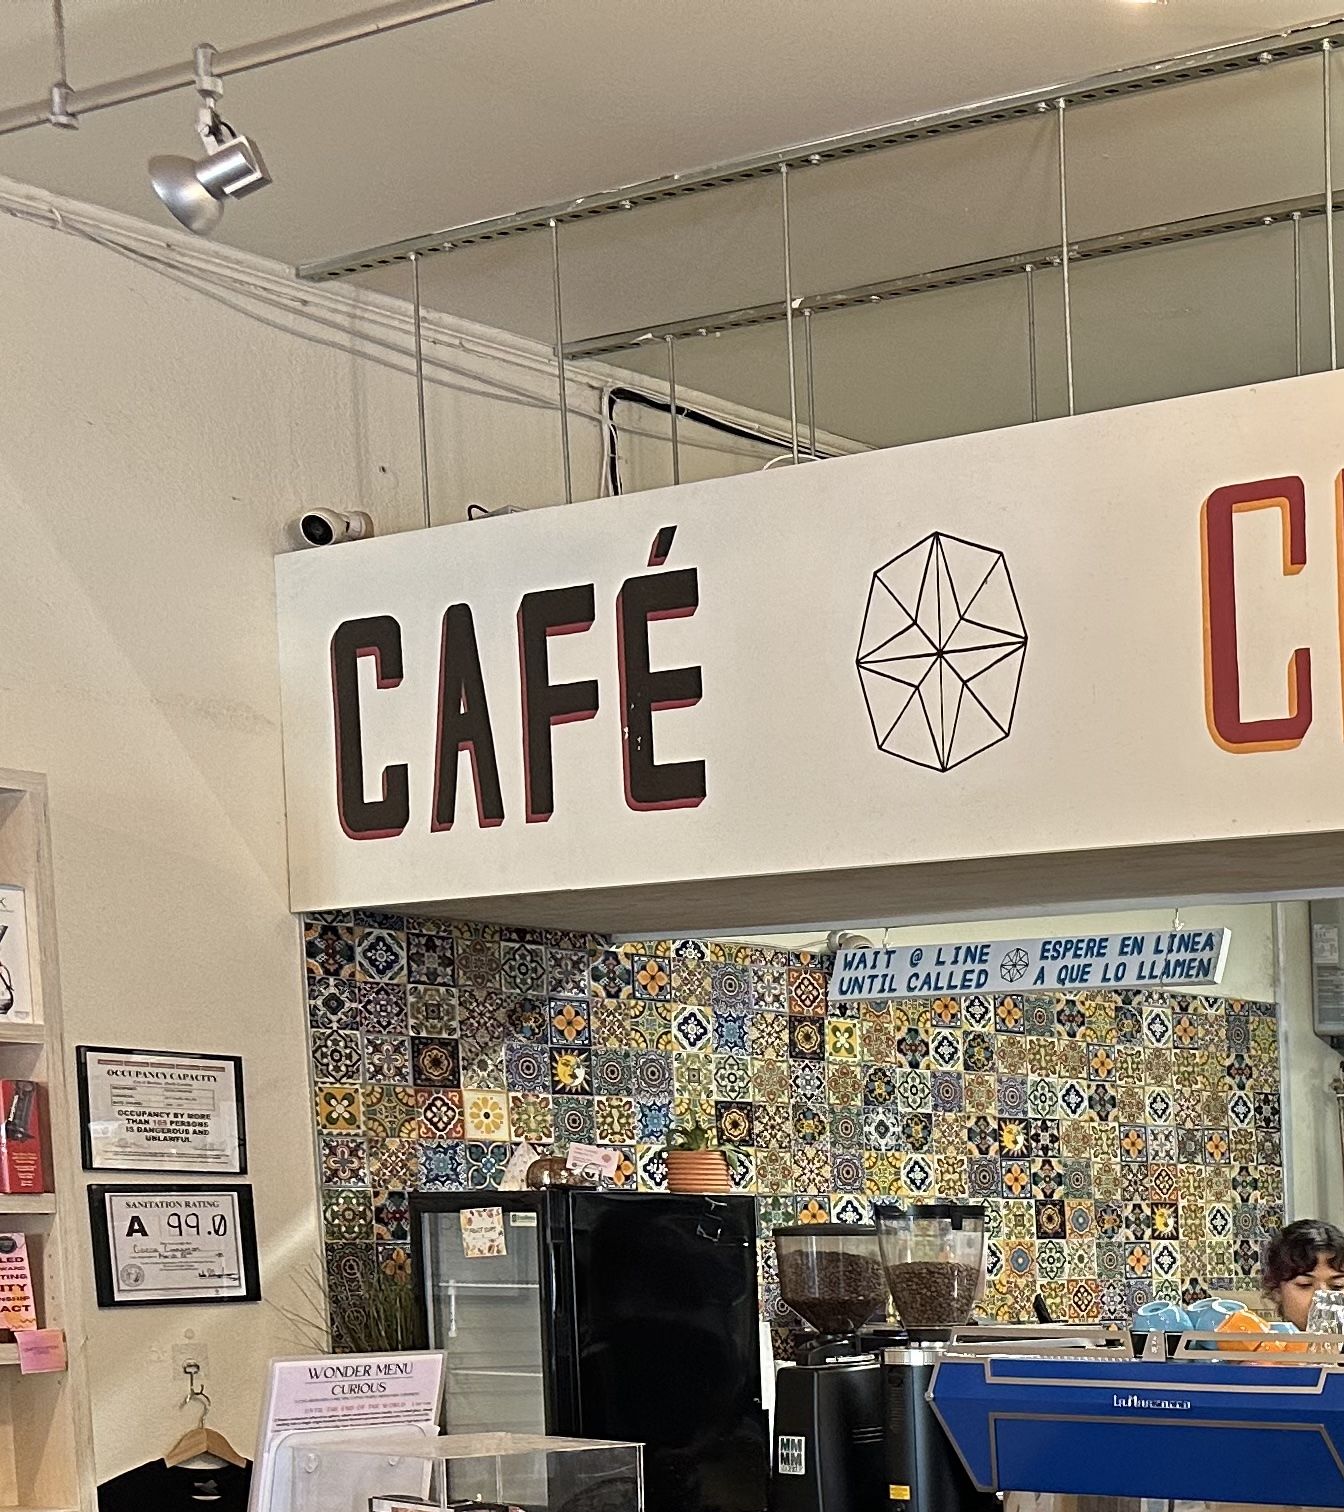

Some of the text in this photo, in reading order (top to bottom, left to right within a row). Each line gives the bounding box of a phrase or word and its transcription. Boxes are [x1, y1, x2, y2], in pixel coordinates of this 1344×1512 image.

[330, 525, 706, 841] CAFÉ
[842, 943, 991, 972] WAIT @ LINE
[1039, 935, 1111, 962] ESPERE
[1118, 935, 1145, 956] EN
[1033, 957, 1213, 986] A QUE LO LLAMEN
[838, 968, 989, 996] UNTIL CALLED
[107, 1069, 167, 1080] OCCUPANCY
[170, 1071, 218, 1083] CAPACITY
[117, 1109, 170, 1119] OCCUPANCY
[126, 1118, 150, 1126] THAN
[125, 1200, 220, 1209] SANITATION RATING
[125, 1215, 149, 1237] A
[308, 1362, 413, 1380] WONDER MENU
[331, 1381, 387, 1396] CURIOUS
